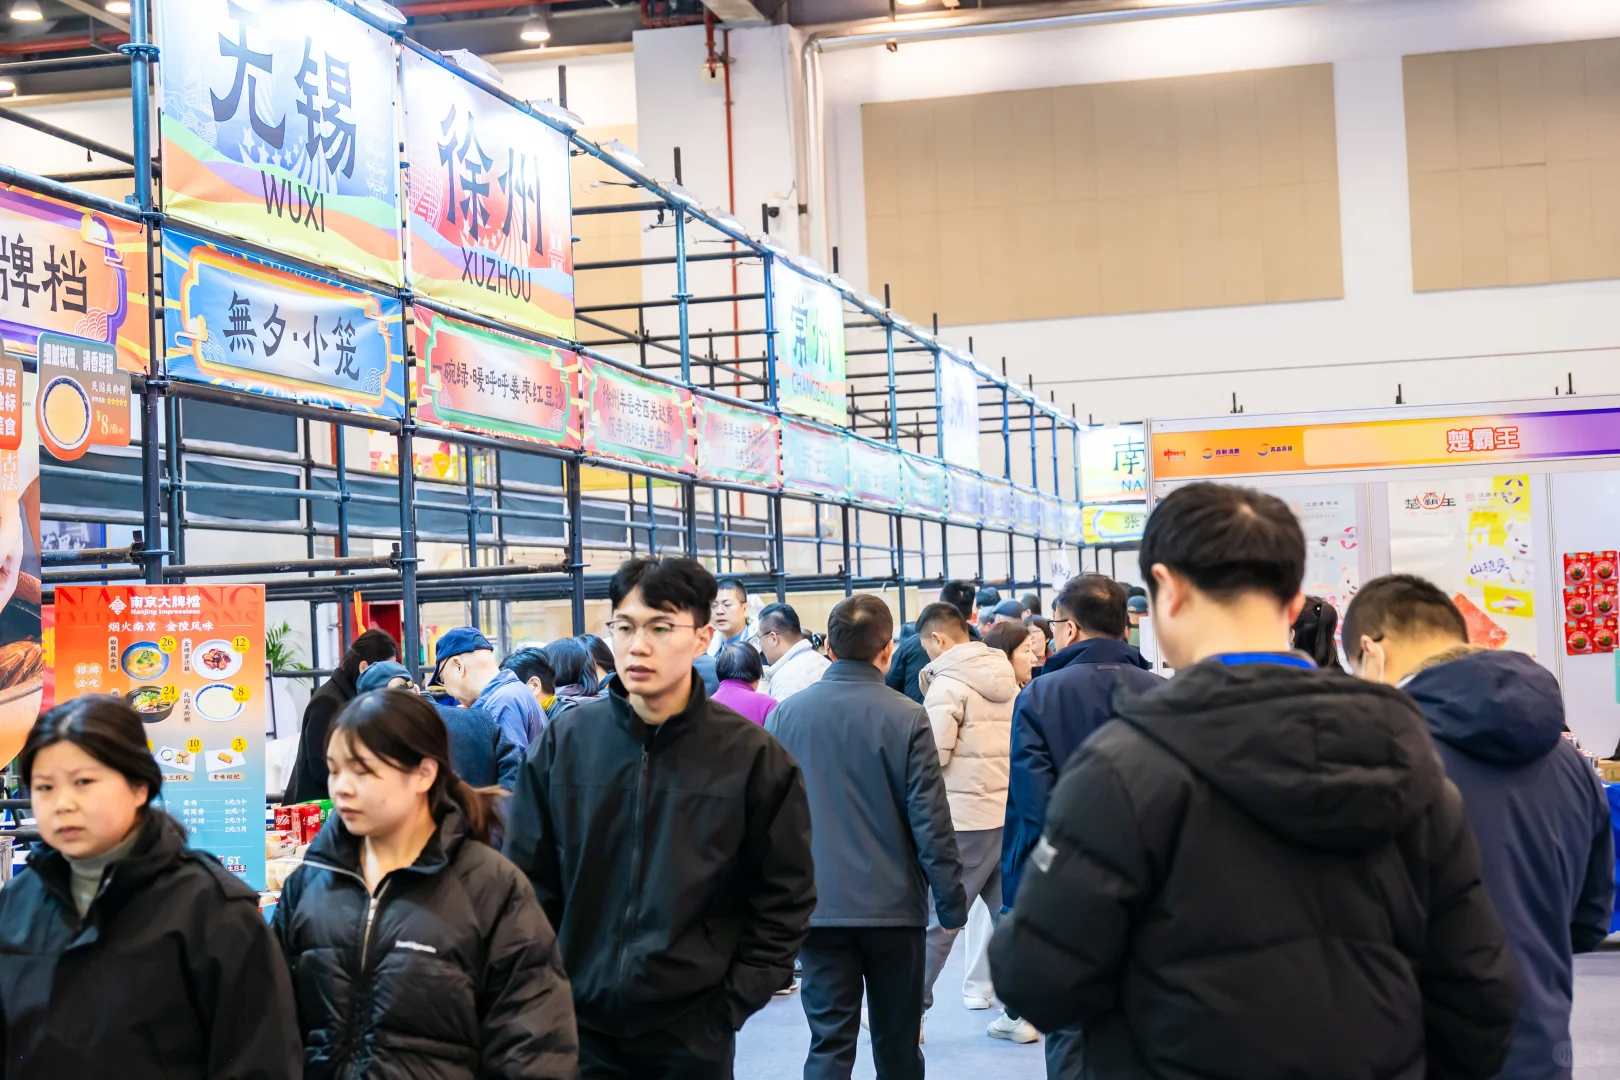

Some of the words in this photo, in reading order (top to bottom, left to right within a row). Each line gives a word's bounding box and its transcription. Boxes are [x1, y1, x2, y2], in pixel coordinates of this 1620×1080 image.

[210, 0, 357, 179] 无锡
[437, 102, 543, 257] 徐州
[260, 170, 325, 232] WUXI
[0, 232, 88, 315] 牌档
[461, 247, 531, 302] XUZHOU
[791, 290, 832, 373] 常州
[1446, 426, 1520, 453] 楚霸王
[1112, 435, 1145, 475] 南
[1122, 480, 1146, 491] NA
[108, 621, 156, 633] 烟火南京
[165, 621, 215, 632] 金陵风味
[161, 638, 173, 647] 26
[235, 638, 246, 647] 12
[76, 679, 99, 689] 必吃
[163, 686, 175, 695] 24
[238, 687, 244, 696] 8
[189, 739, 199, 747] 10
[235, 738, 242, 747] 3
